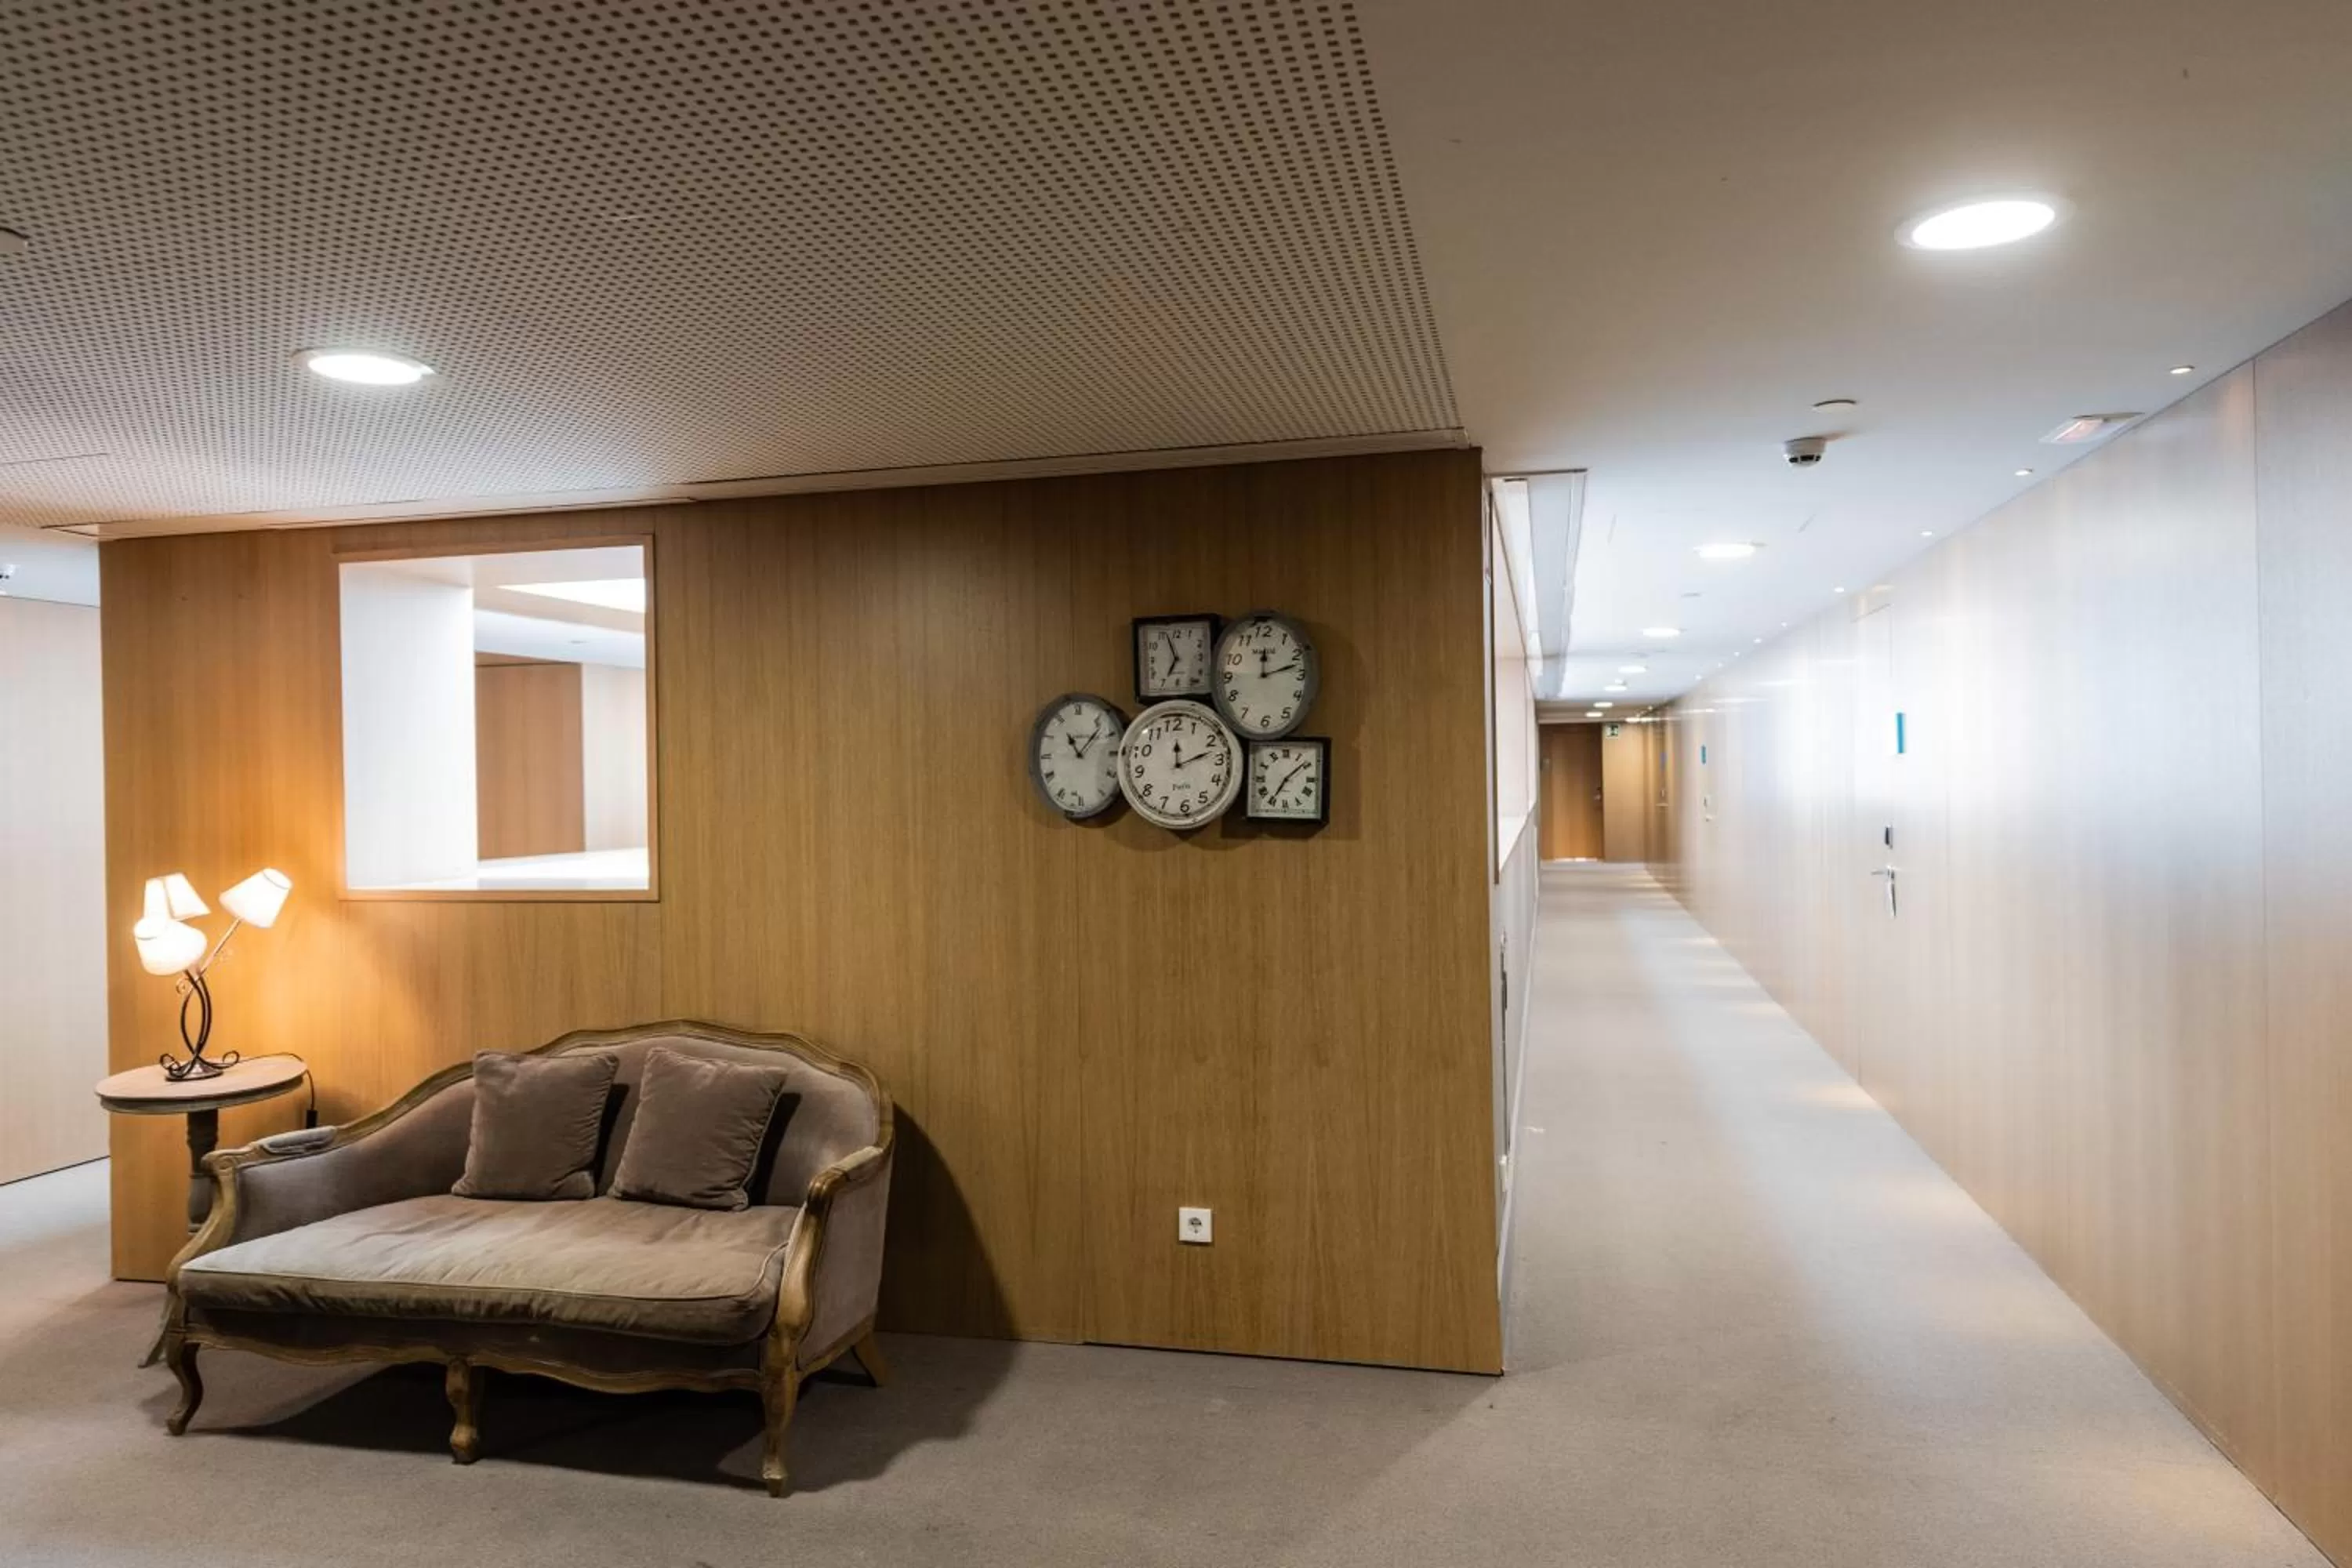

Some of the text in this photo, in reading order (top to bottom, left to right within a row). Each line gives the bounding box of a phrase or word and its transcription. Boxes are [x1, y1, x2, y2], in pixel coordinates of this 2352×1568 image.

[1254, 626, 1272, 637] 12
[1238, 634, 1252, 647] 11
[1281, 633, 1288, 645] 1
[1227, 653, 1243, 666] 10
[1292, 648, 1303, 661] 2
[1223, 671, 1233, 684] 9
[1296, 668, 1305, 681] 3
[1228, 689, 1239, 702] 8
[1294, 690, 1302, 701] 4
[1241, 707, 1249, 719] 7
[1281, 707, 1292, 719] 5
[1164, 717, 1183, 732] 12
[1260, 715, 1272, 728] 6
[1149, 727, 1162, 741] 11
[1191, 722, 1197, 735] 1
[1205, 735, 1217, 748] 2
[1214, 753, 1225, 766] 3
[1134, 764, 1145, 779] 9
[1211, 774, 1222, 786] 4
[1142, 783, 1153, 797] 8
[1160, 796, 1169, 810] 7
[1198, 790, 1209, 804] 5
[1179, 800, 1190, 813] 6
